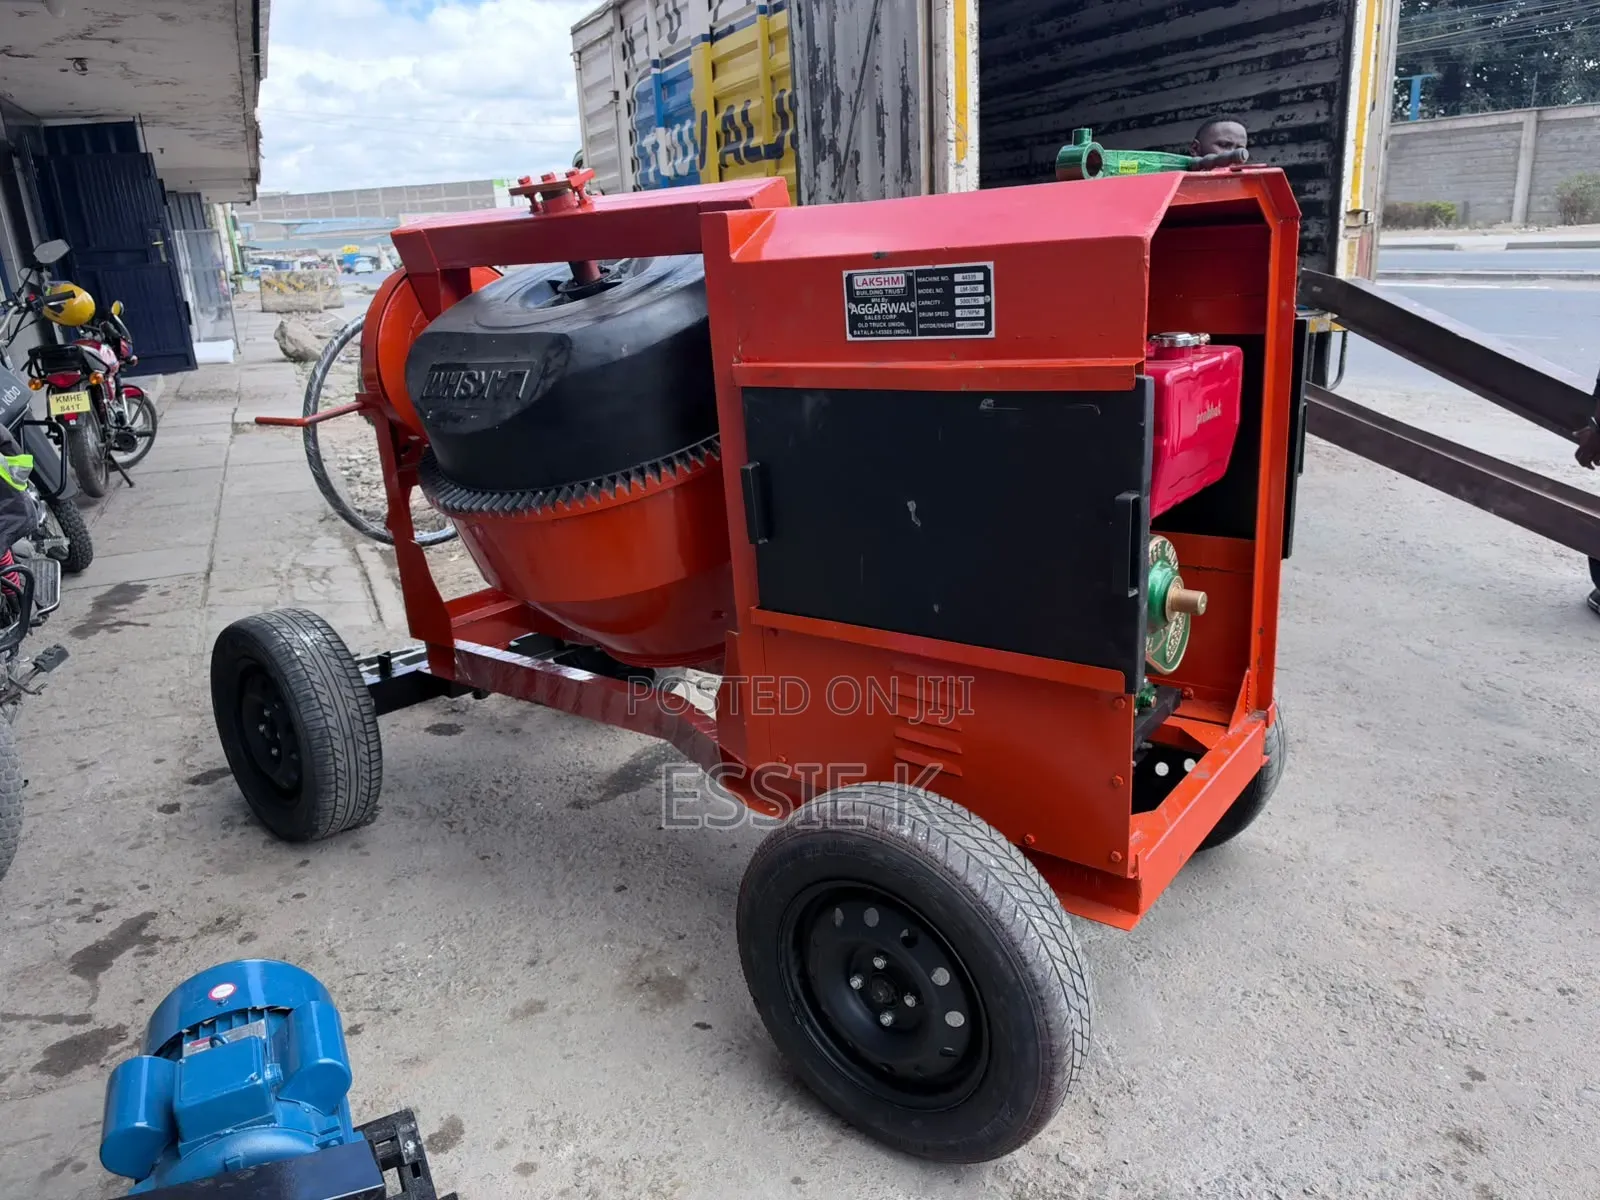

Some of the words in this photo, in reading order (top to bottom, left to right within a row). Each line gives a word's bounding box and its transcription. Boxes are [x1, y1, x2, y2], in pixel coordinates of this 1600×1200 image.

[855, 275, 904, 288] LAKSHMI
[850, 302, 914, 315] AGGARWAL
[55, 393, 83, 403] KMHE
